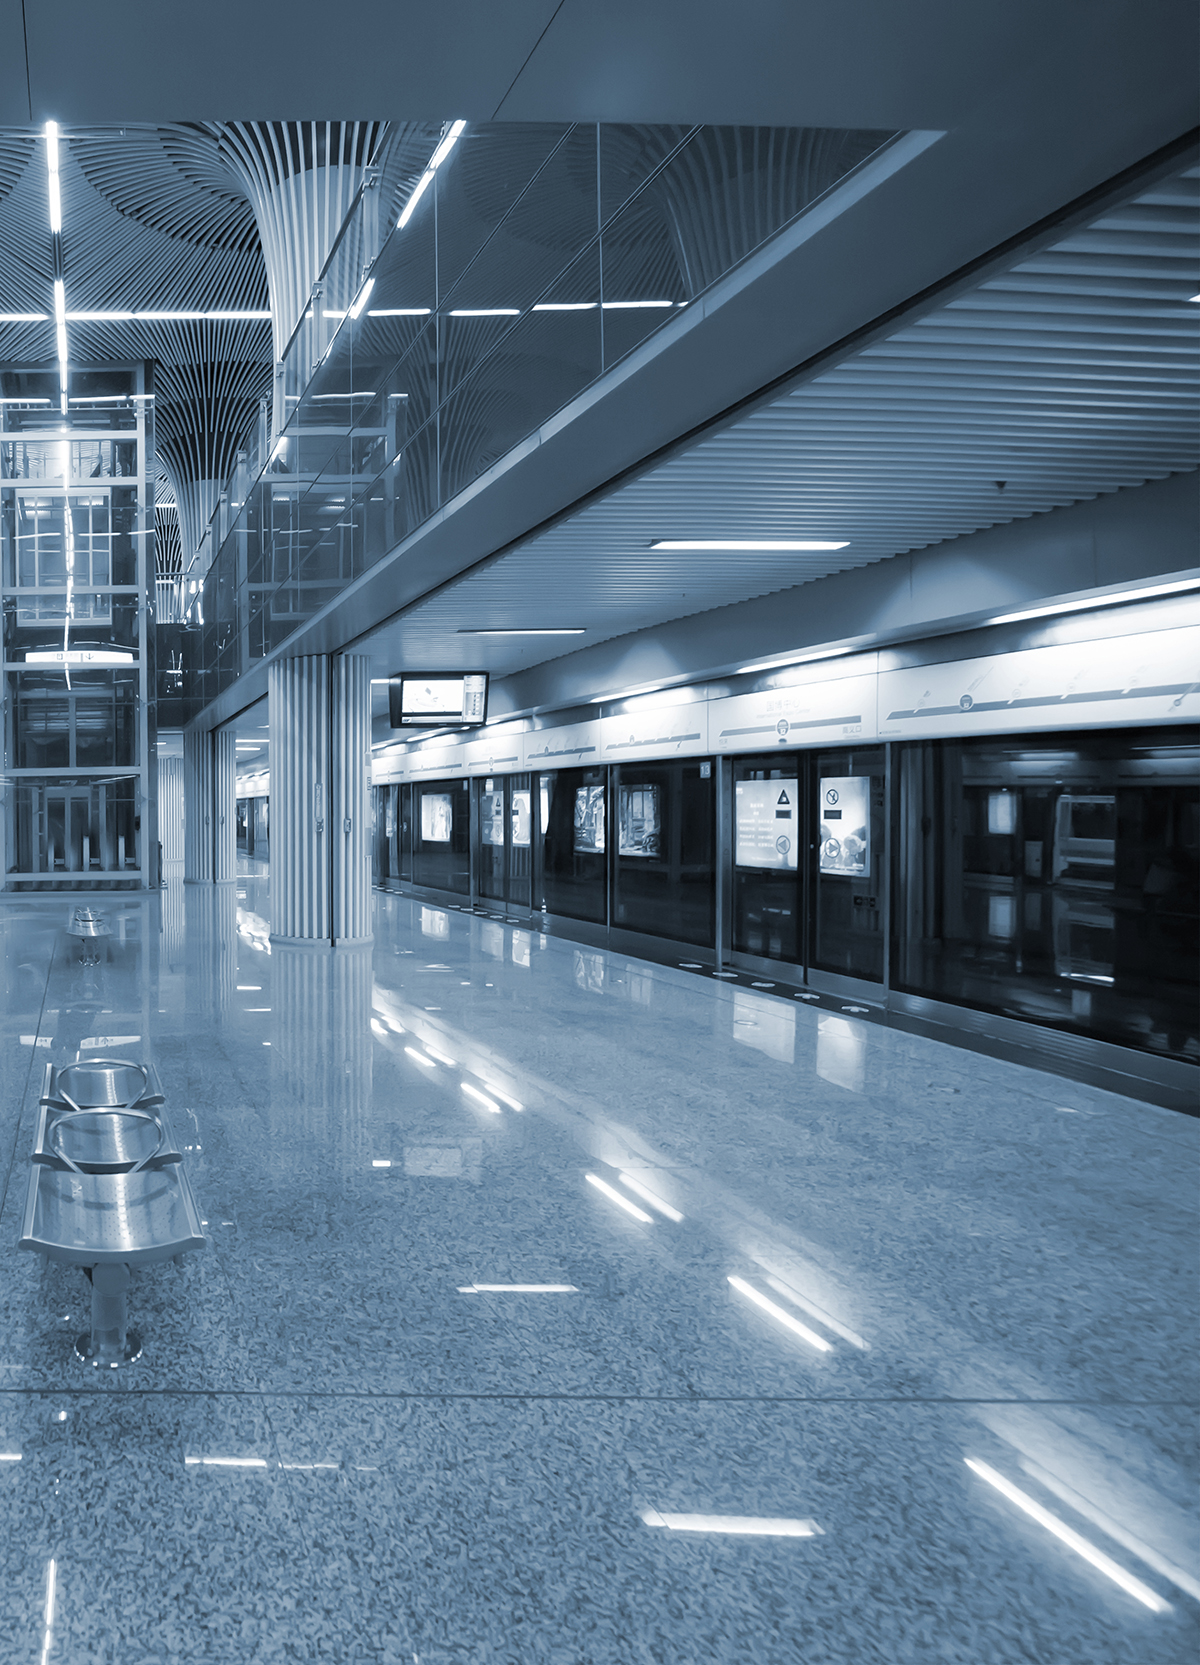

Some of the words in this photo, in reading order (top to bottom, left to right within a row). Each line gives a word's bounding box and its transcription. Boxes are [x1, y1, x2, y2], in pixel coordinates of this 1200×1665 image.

[766, 699, 801, 712] 国博中心
[701, 764, 710, 775] 13
